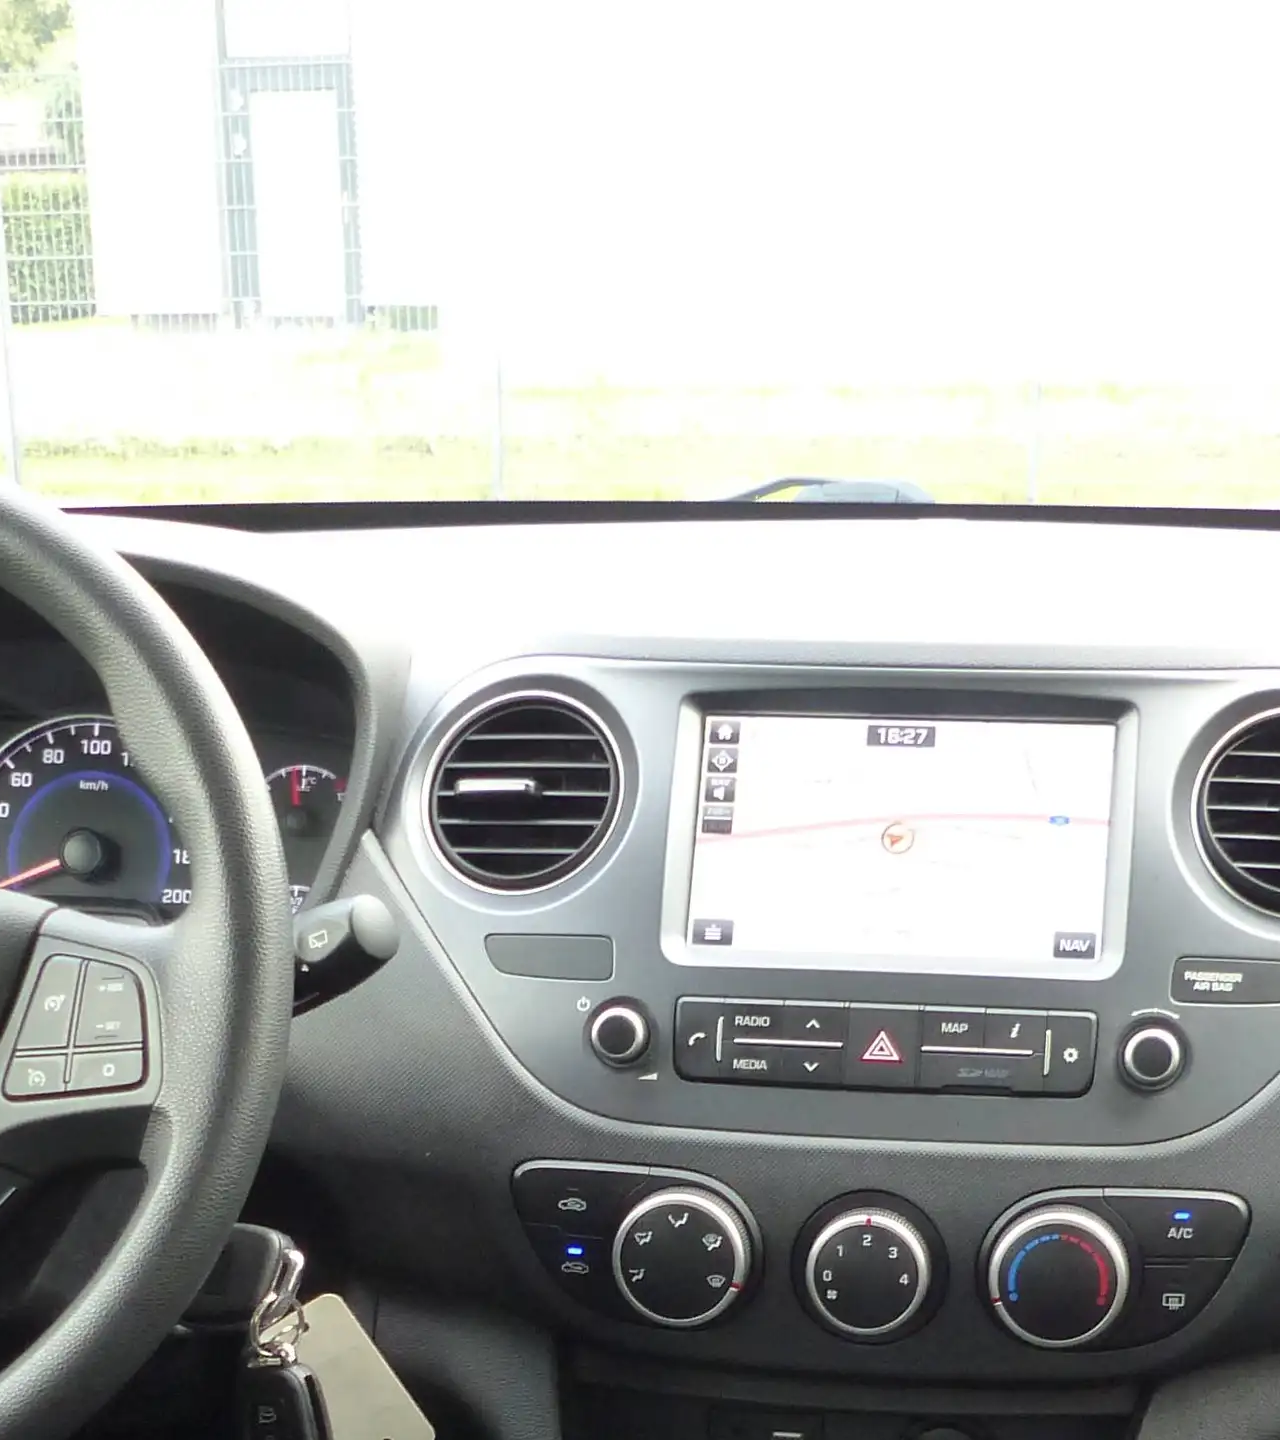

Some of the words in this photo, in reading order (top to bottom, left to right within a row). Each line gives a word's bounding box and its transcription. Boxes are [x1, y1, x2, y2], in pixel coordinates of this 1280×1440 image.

[81, 739, 112, 755] 100
[42, 749, 64, 764] 80
[10, 772, 33, 788] 60
[79, 780, 109, 791] km/h
[161, 889, 192, 904] 200
[1059, 938, 1091, 952] NAV
[734, 1015, 771, 1028] RADIO
[941, 1022, 969, 1034] MAP
[732, 1059, 768, 1071] MEDIA
[862, 1234, 873, 1247] 2
[1167, 1227, 1194, 1240] A/C
[836, 1244, 844, 1258] 1
[888, 1246, 899, 1260] 3
[822, 1269, 833, 1283] 0
[899, 1273, 910, 1286] 4
